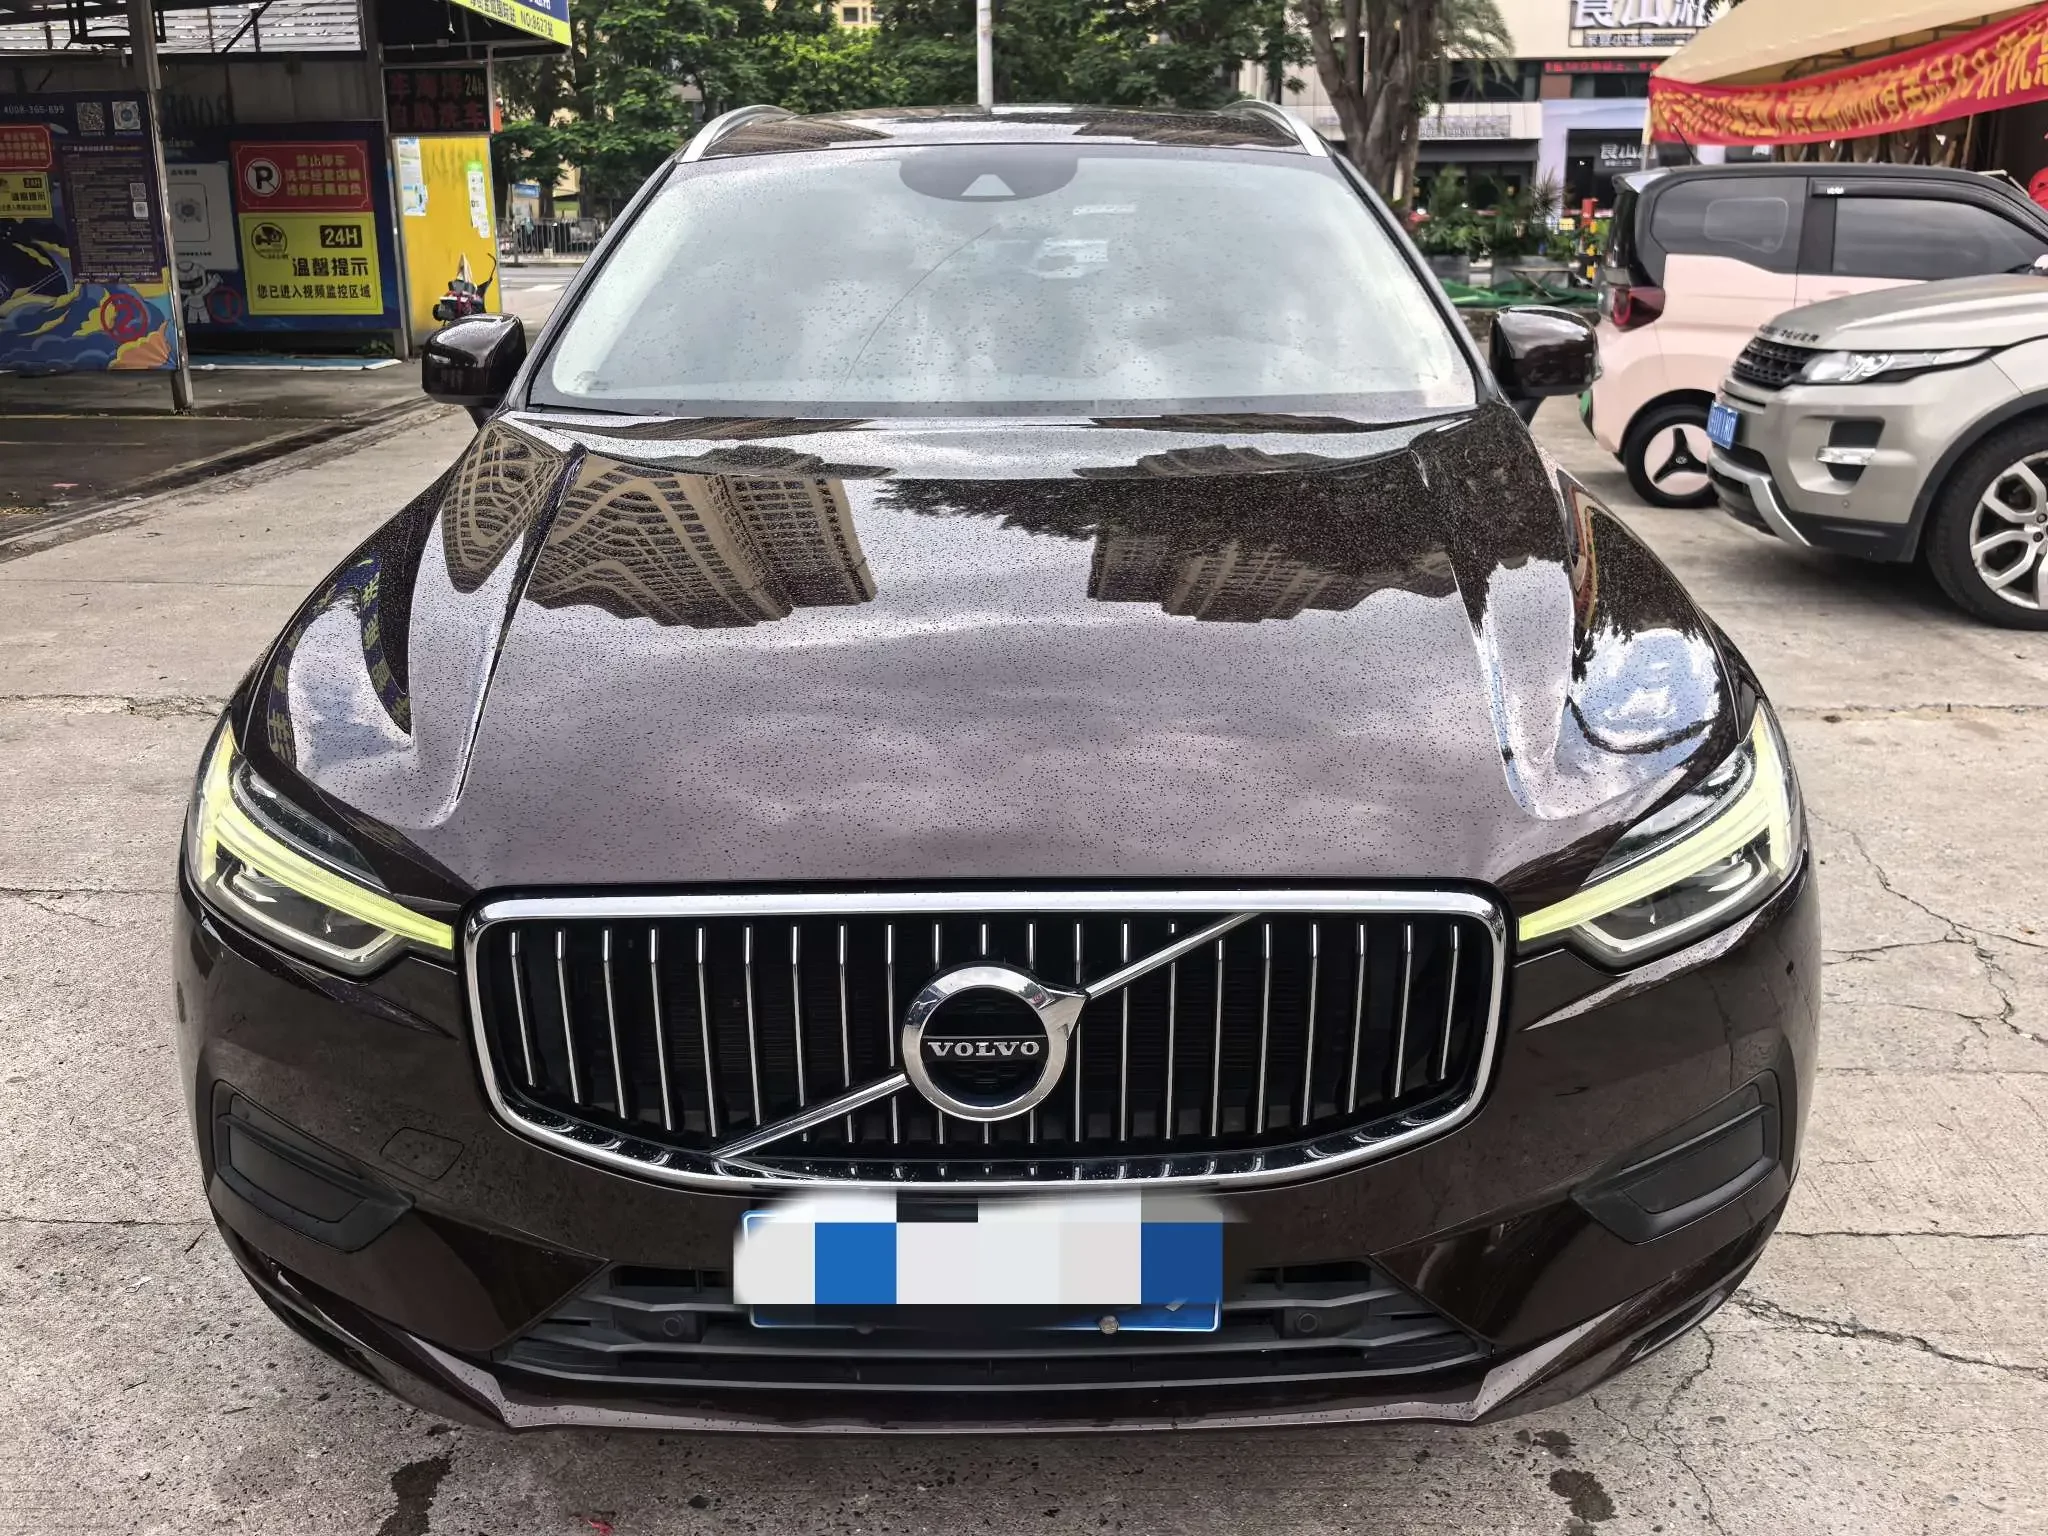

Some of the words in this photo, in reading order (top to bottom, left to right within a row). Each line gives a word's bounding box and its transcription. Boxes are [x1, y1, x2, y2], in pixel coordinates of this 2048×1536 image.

[324, 227, 359, 246] 24H
[292, 257, 369, 277] 温馨提示
[257, 283, 371, 299] 您已进入视频监控区域
[927, 1041, 1040, 1057] VOLVO
